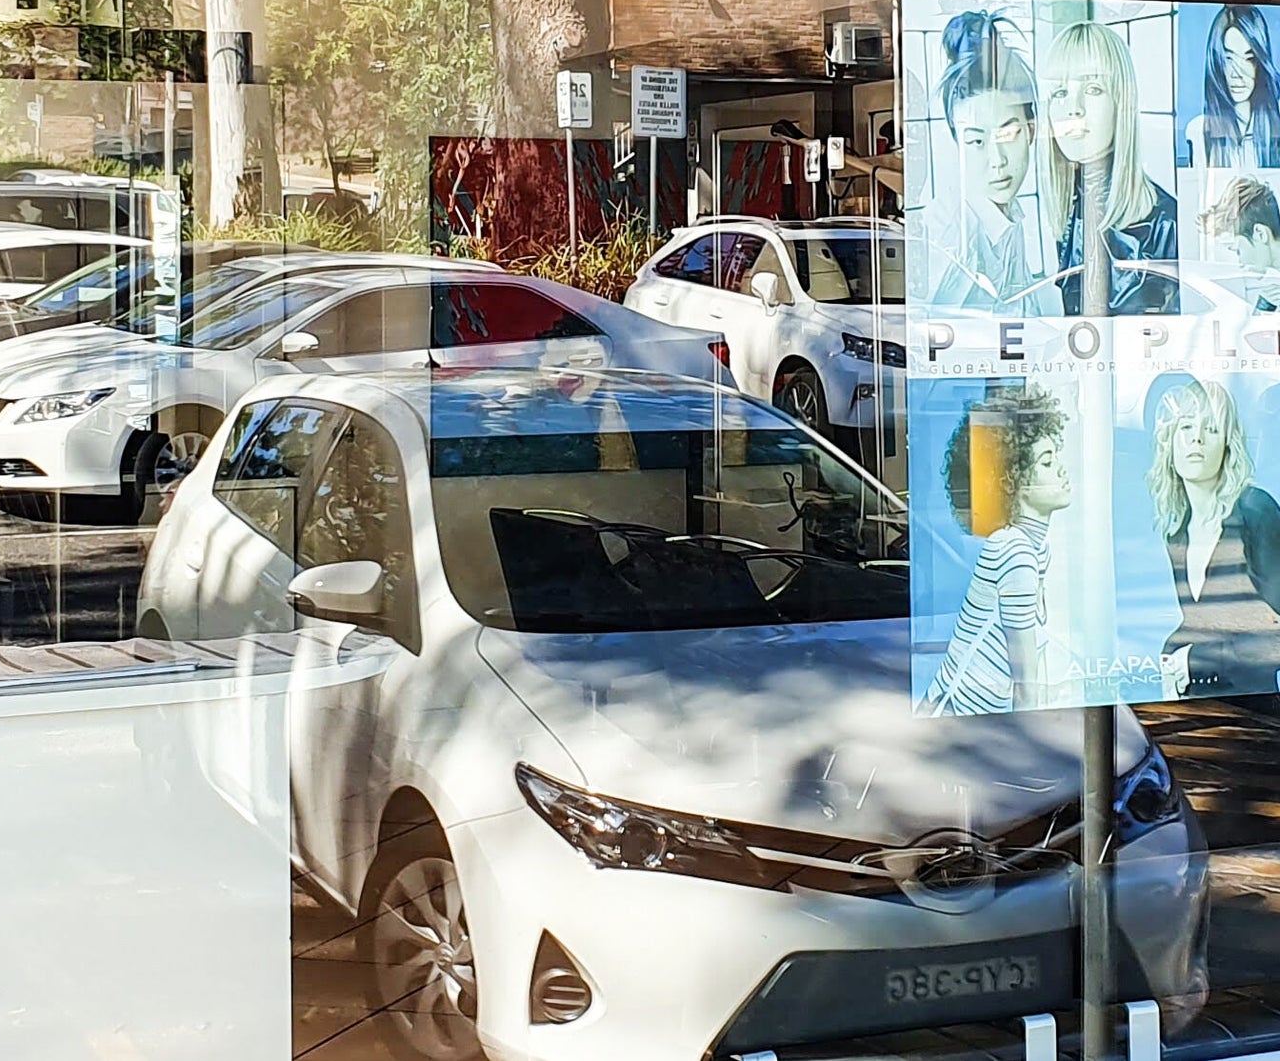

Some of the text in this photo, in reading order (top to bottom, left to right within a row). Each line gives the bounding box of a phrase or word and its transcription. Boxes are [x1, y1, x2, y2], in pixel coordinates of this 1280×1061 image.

[929, 361, 998, 375] GLOBAL
[1009, 360, 1075, 373] BEAUTY
[1086, 360, 1116, 373] FOR
[1128, 360, 1231, 371] ONNECTED
[1086, 675, 1164, 688] MILANO
